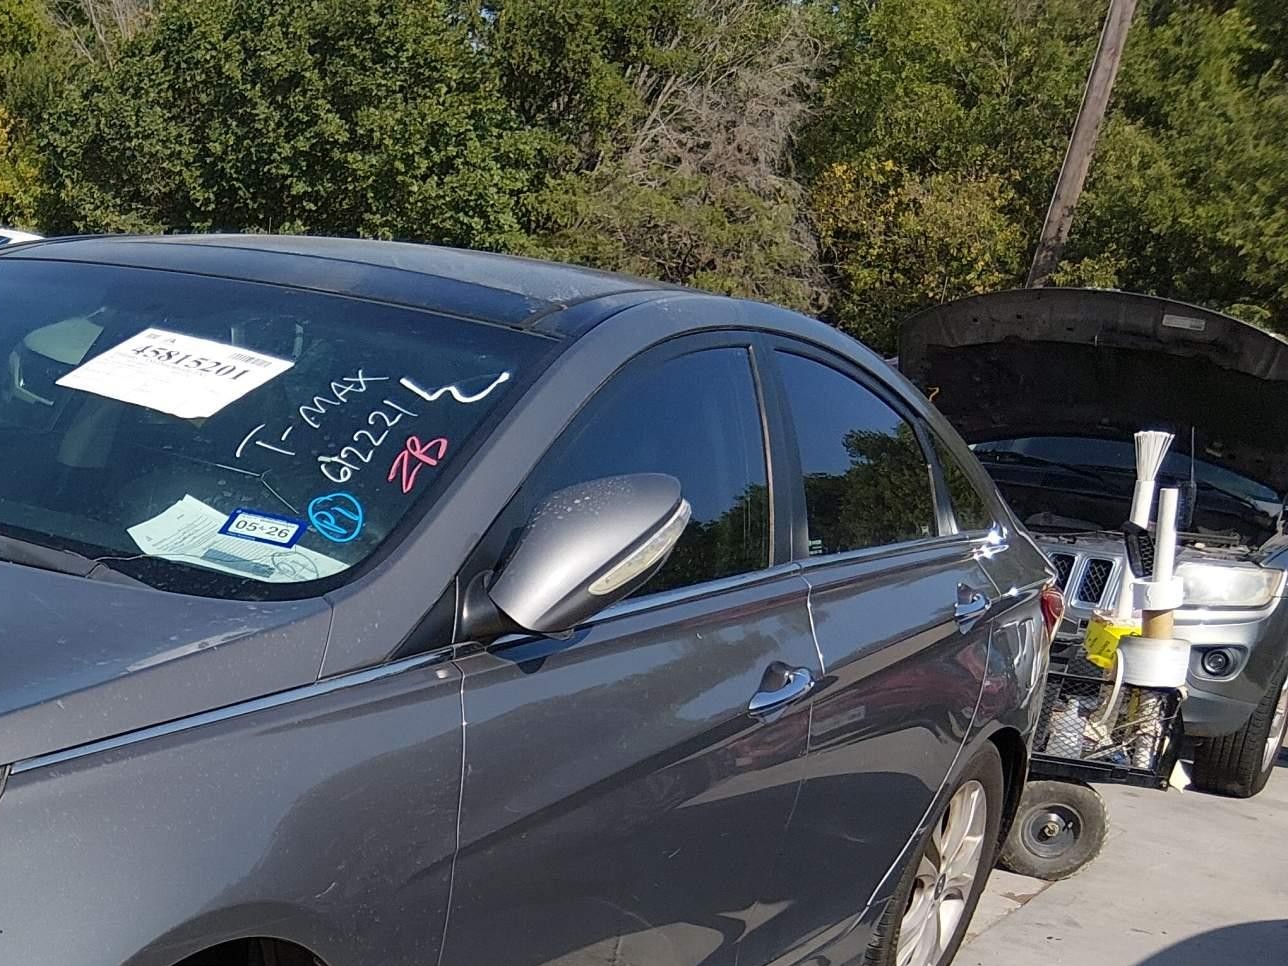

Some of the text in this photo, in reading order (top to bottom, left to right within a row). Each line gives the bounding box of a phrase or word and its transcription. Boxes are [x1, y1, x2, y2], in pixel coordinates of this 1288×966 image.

[131, 343, 252, 381] 45815201
[235, 368, 390, 458] T-MAX
[266, 524, 291, 539] 26
